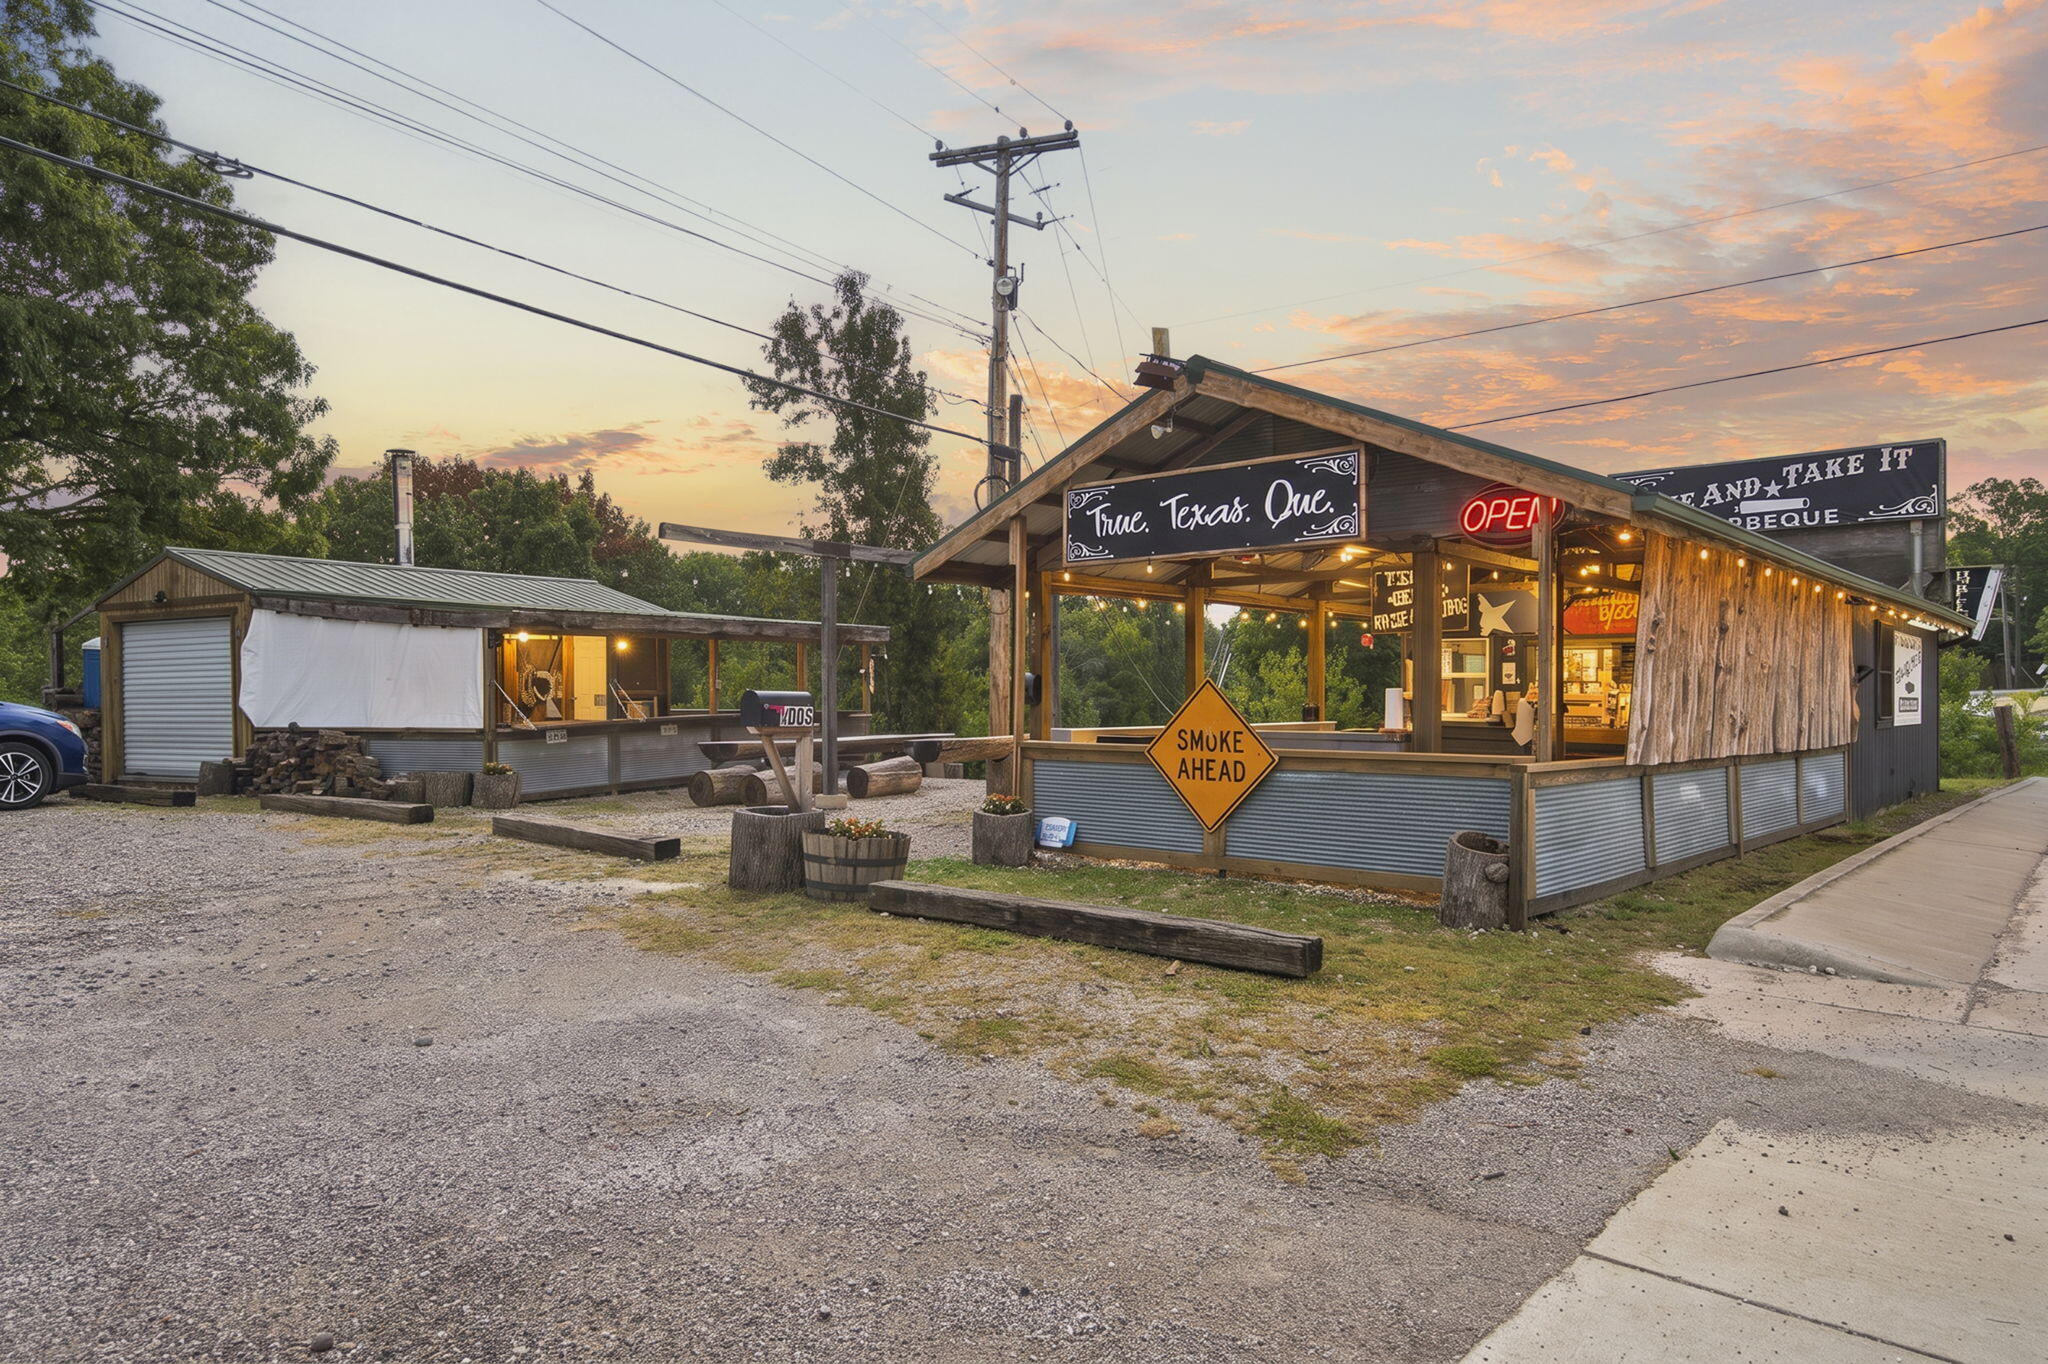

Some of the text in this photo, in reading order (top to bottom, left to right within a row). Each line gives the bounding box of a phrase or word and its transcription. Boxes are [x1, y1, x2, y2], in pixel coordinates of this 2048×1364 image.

[1699, 477, 1762, 508] AND
[1782, 453, 1865, 490] TAKE
[1879, 447, 1913, 472] IT
[1086, 479, 1335, 538] True. Texas. Que.
[1463, 496, 1557, 532] OPEN
[1177, 728, 1245, 754] SMOKE
[1177, 757, 1246, 783] AHEAD
